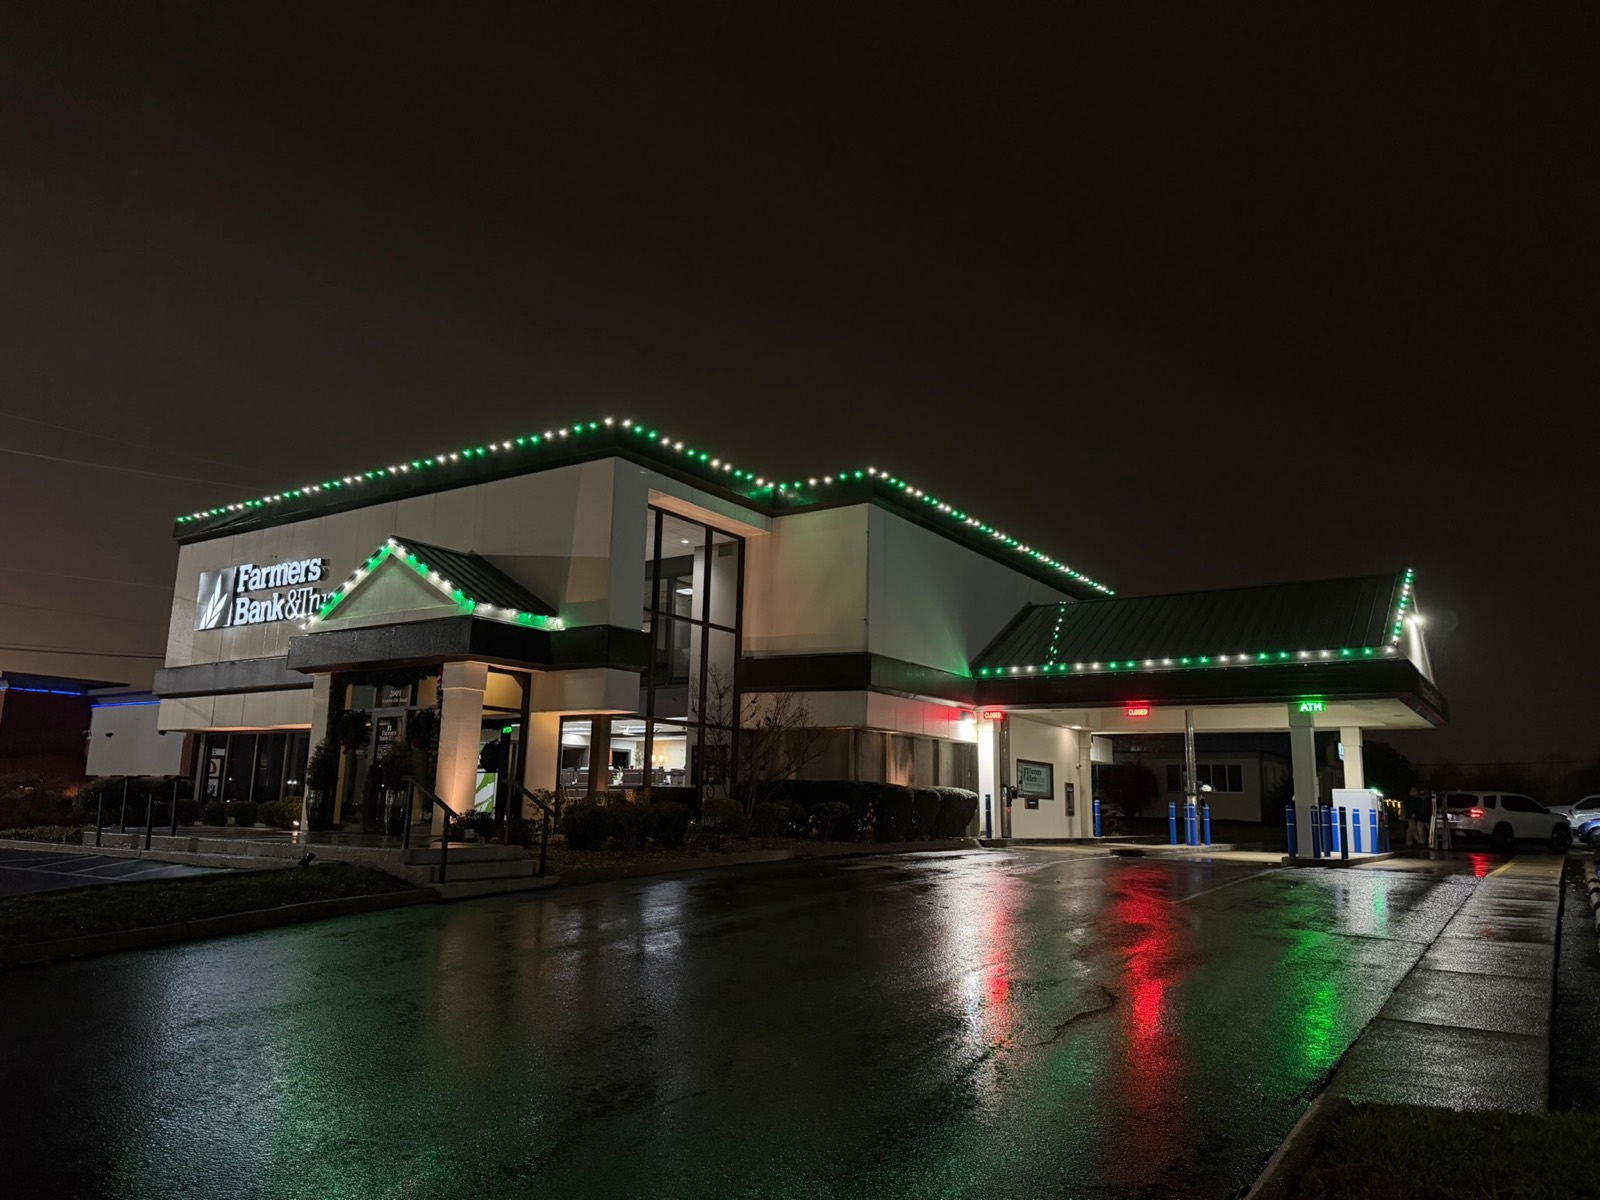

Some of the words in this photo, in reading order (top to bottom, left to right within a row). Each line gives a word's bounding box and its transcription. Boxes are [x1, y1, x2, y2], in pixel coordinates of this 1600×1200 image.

[236, 558, 322, 592] Farmers
[233, 592, 284, 626] Bank
[1300, 702, 1322, 712] ATM
